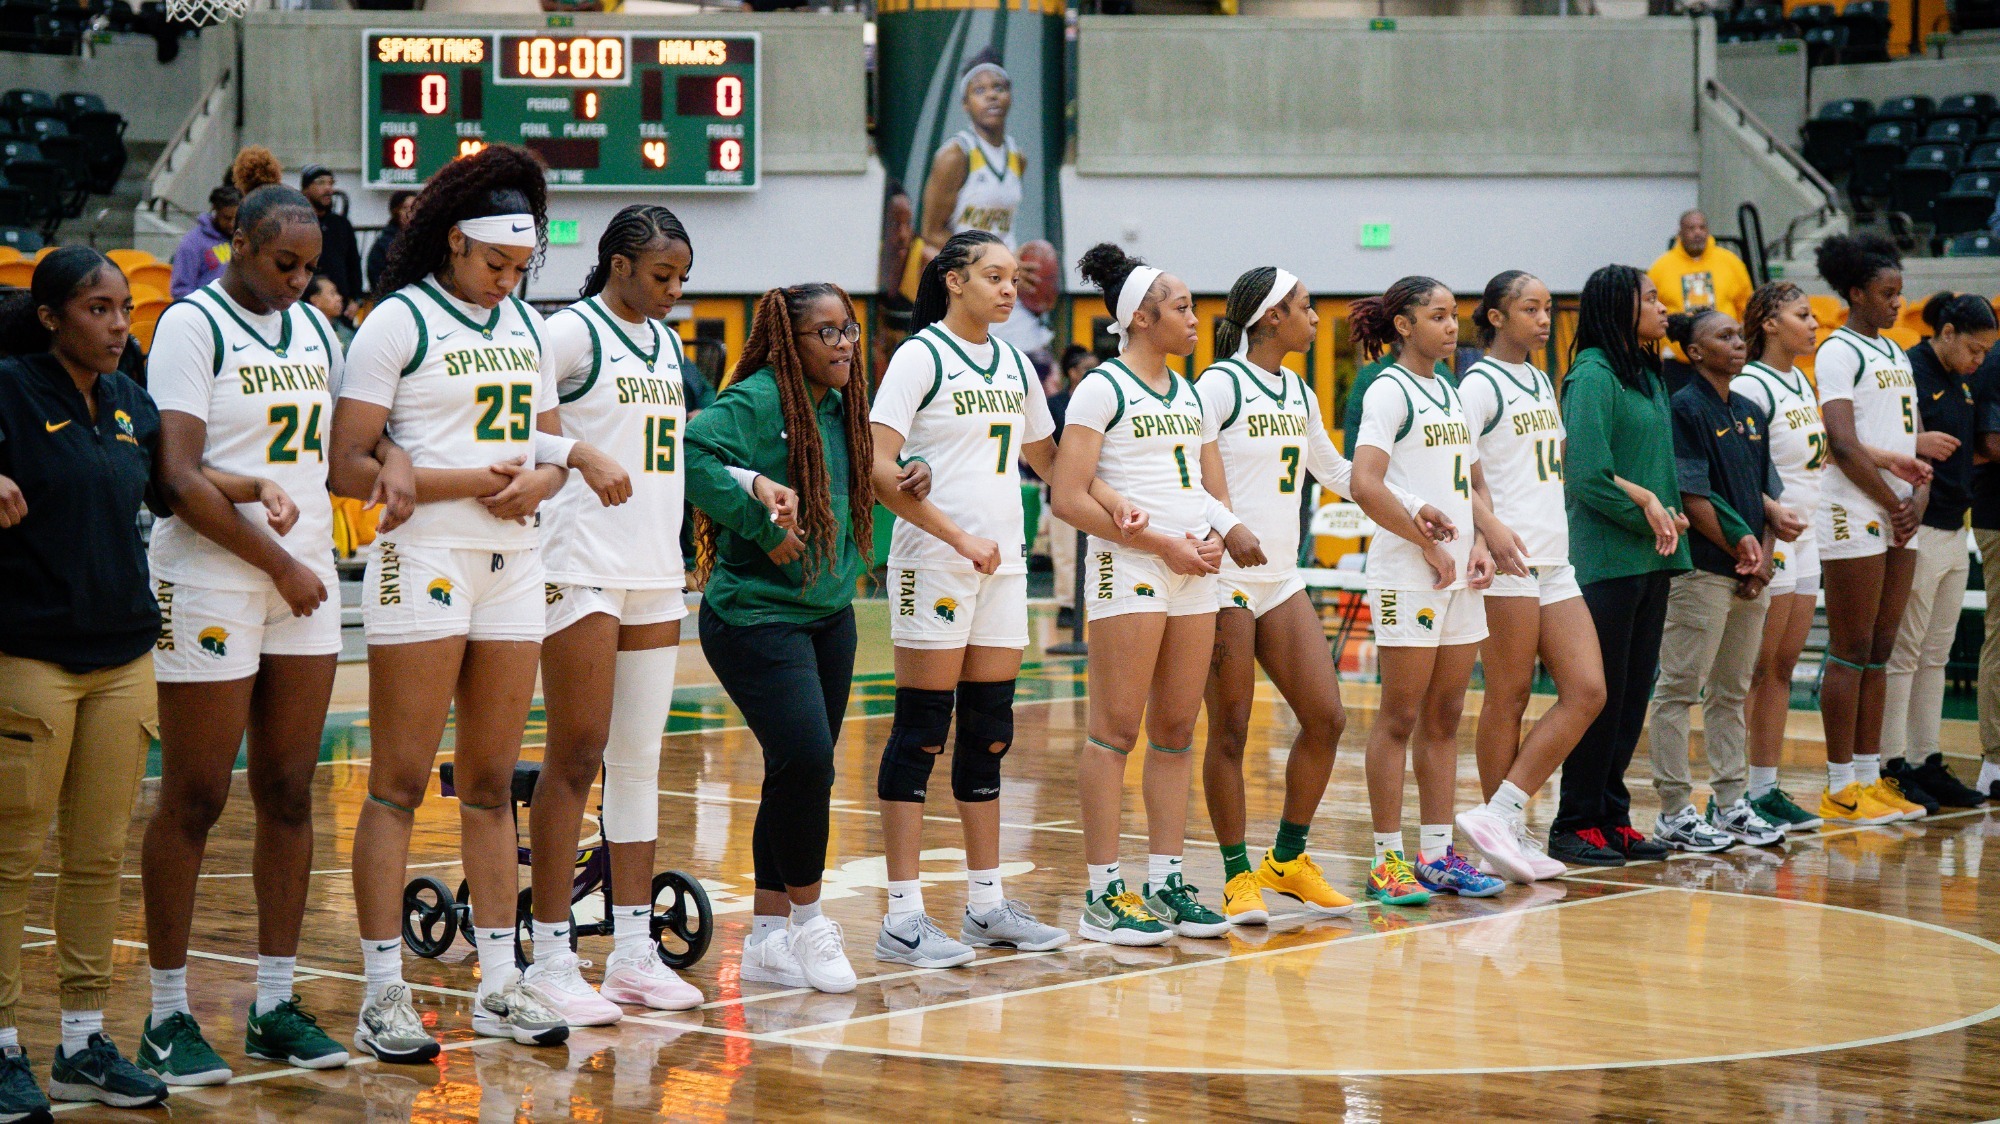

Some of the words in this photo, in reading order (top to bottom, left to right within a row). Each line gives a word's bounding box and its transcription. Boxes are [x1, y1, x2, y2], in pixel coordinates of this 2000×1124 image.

[378, 37, 484, 63] SPARTANS
[518, 38, 622, 78] 10:00
[659, 40, 726, 65] HAWKS
[421, 74, 447, 114] 0
[526, 97, 570, 112] PERIOD
[585, 92, 597, 118] 1
[716, 76, 742, 116] 0
[380, 122, 418, 136] FOULS
[520, 122, 551, 137] FOUL
[563, 123, 608, 138] PLAYER
[706, 123, 745, 138] FOULS
[393, 138, 414, 168] 0
[643, 142, 666, 167] 4
[719, 140, 741, 170] 0
[705, 170, 744, 184] SCORE
[473, 382, 532, 442] 25
[1900, 395, 1914, 434] 5
[266, 401, 324, 464] 24
[643, 415, 677, 474] 15
[987, 423, 1012, 475] 7
[1172, 443, 1193, 490] 1
[1279, 444, 1300, 494] 3
[1453, 453, 1469, 500] 4
[1534, 437, 1564, 484] 14
